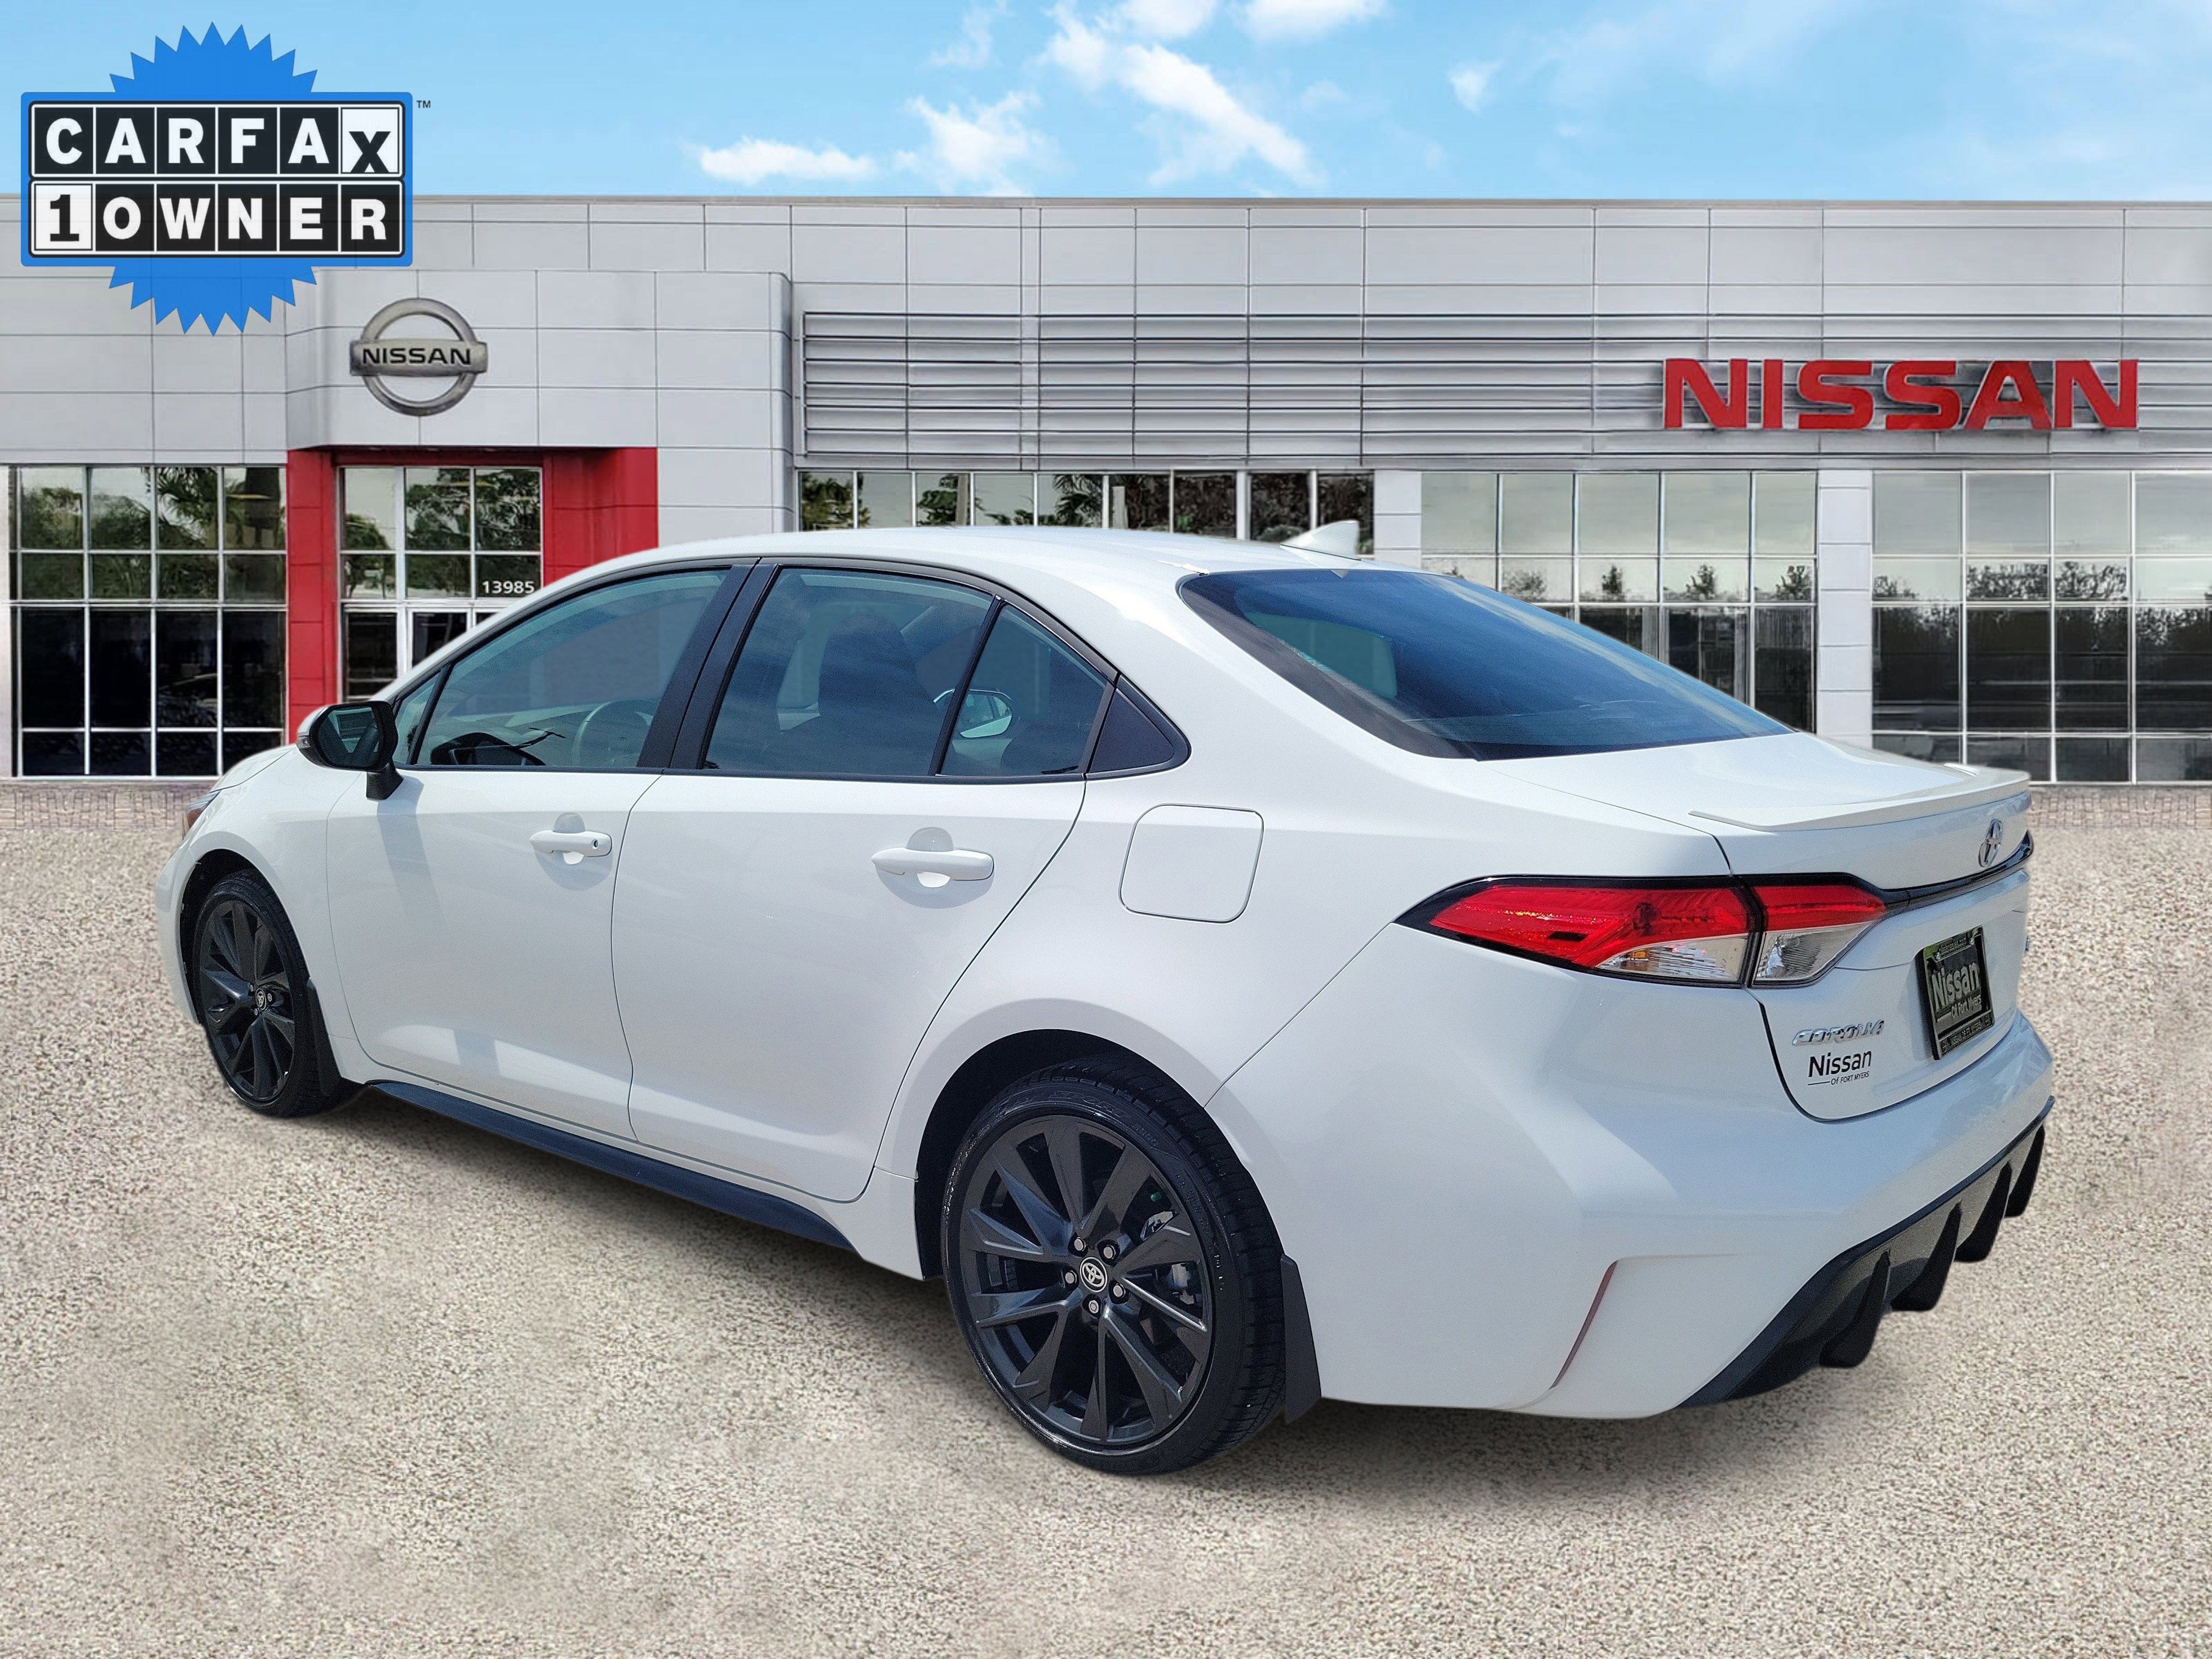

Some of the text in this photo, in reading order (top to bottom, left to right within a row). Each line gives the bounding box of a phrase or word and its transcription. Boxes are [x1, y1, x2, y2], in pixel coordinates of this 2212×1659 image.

[362, 347, 471, 365] NISSAN
[1664, 358, 2139, 430] NISSAN
[482, 580, 535, 594] 13985
[1931, 962, 1981, 1014] Nissan
[1808, 1050, 1872, 1078] Nissan
[1840, 1074, 1853, 1083] FORT
[1854, 1071, 1870, 1081] MYERS
